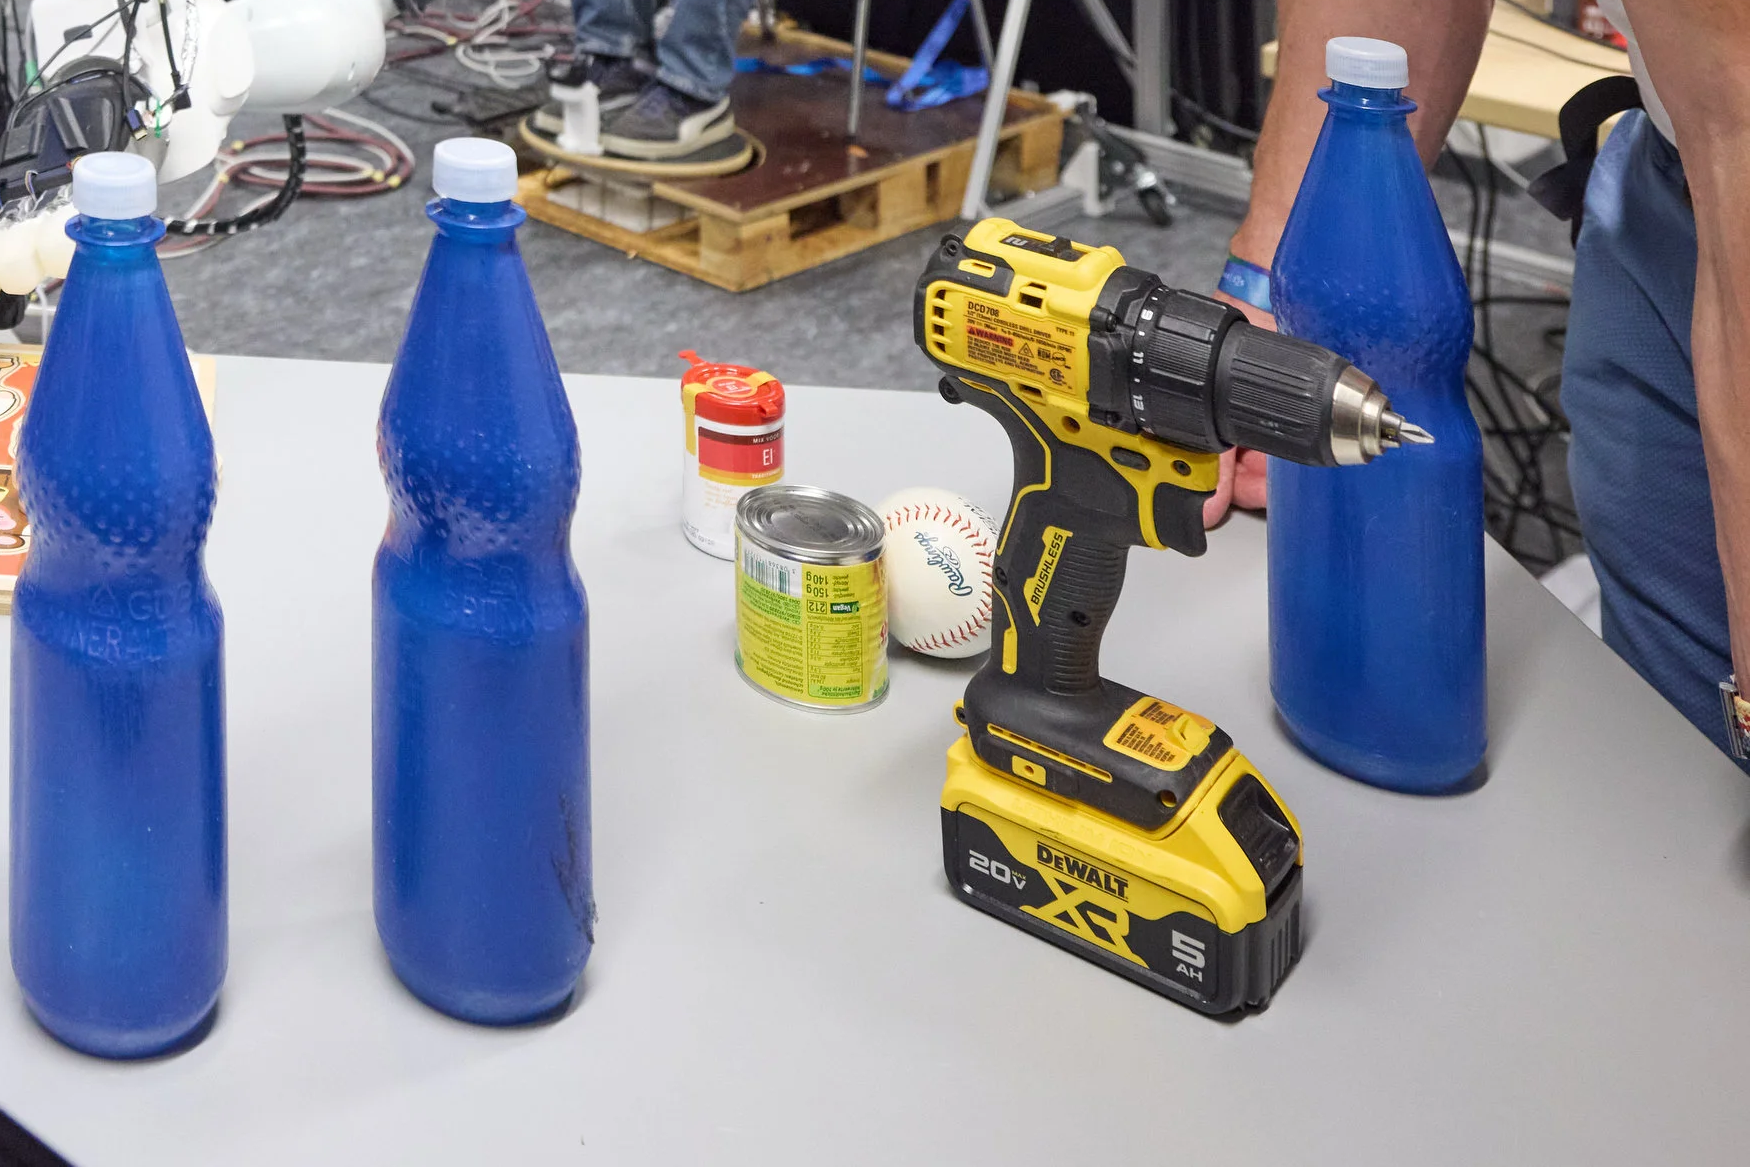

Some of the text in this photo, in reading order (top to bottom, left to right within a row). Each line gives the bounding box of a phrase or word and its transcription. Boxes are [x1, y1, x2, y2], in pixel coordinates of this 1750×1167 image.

[968, 301, 1000, 317] DCD708
[975, 328, 1014, 347] WARNING
[763, 448, 773, 466] EI
[914, 531, 973, 597] Rawlings
[1029, 531, 1064, 606] BRUSHLESS
[809, 601, 826, 612] 212
[832, 604, 851, 612] Vegan
[1020, 870, 1150, 970] XR
[1171, 929, 1206, 969] 5
[1176, 963, 1203, 983] AH
